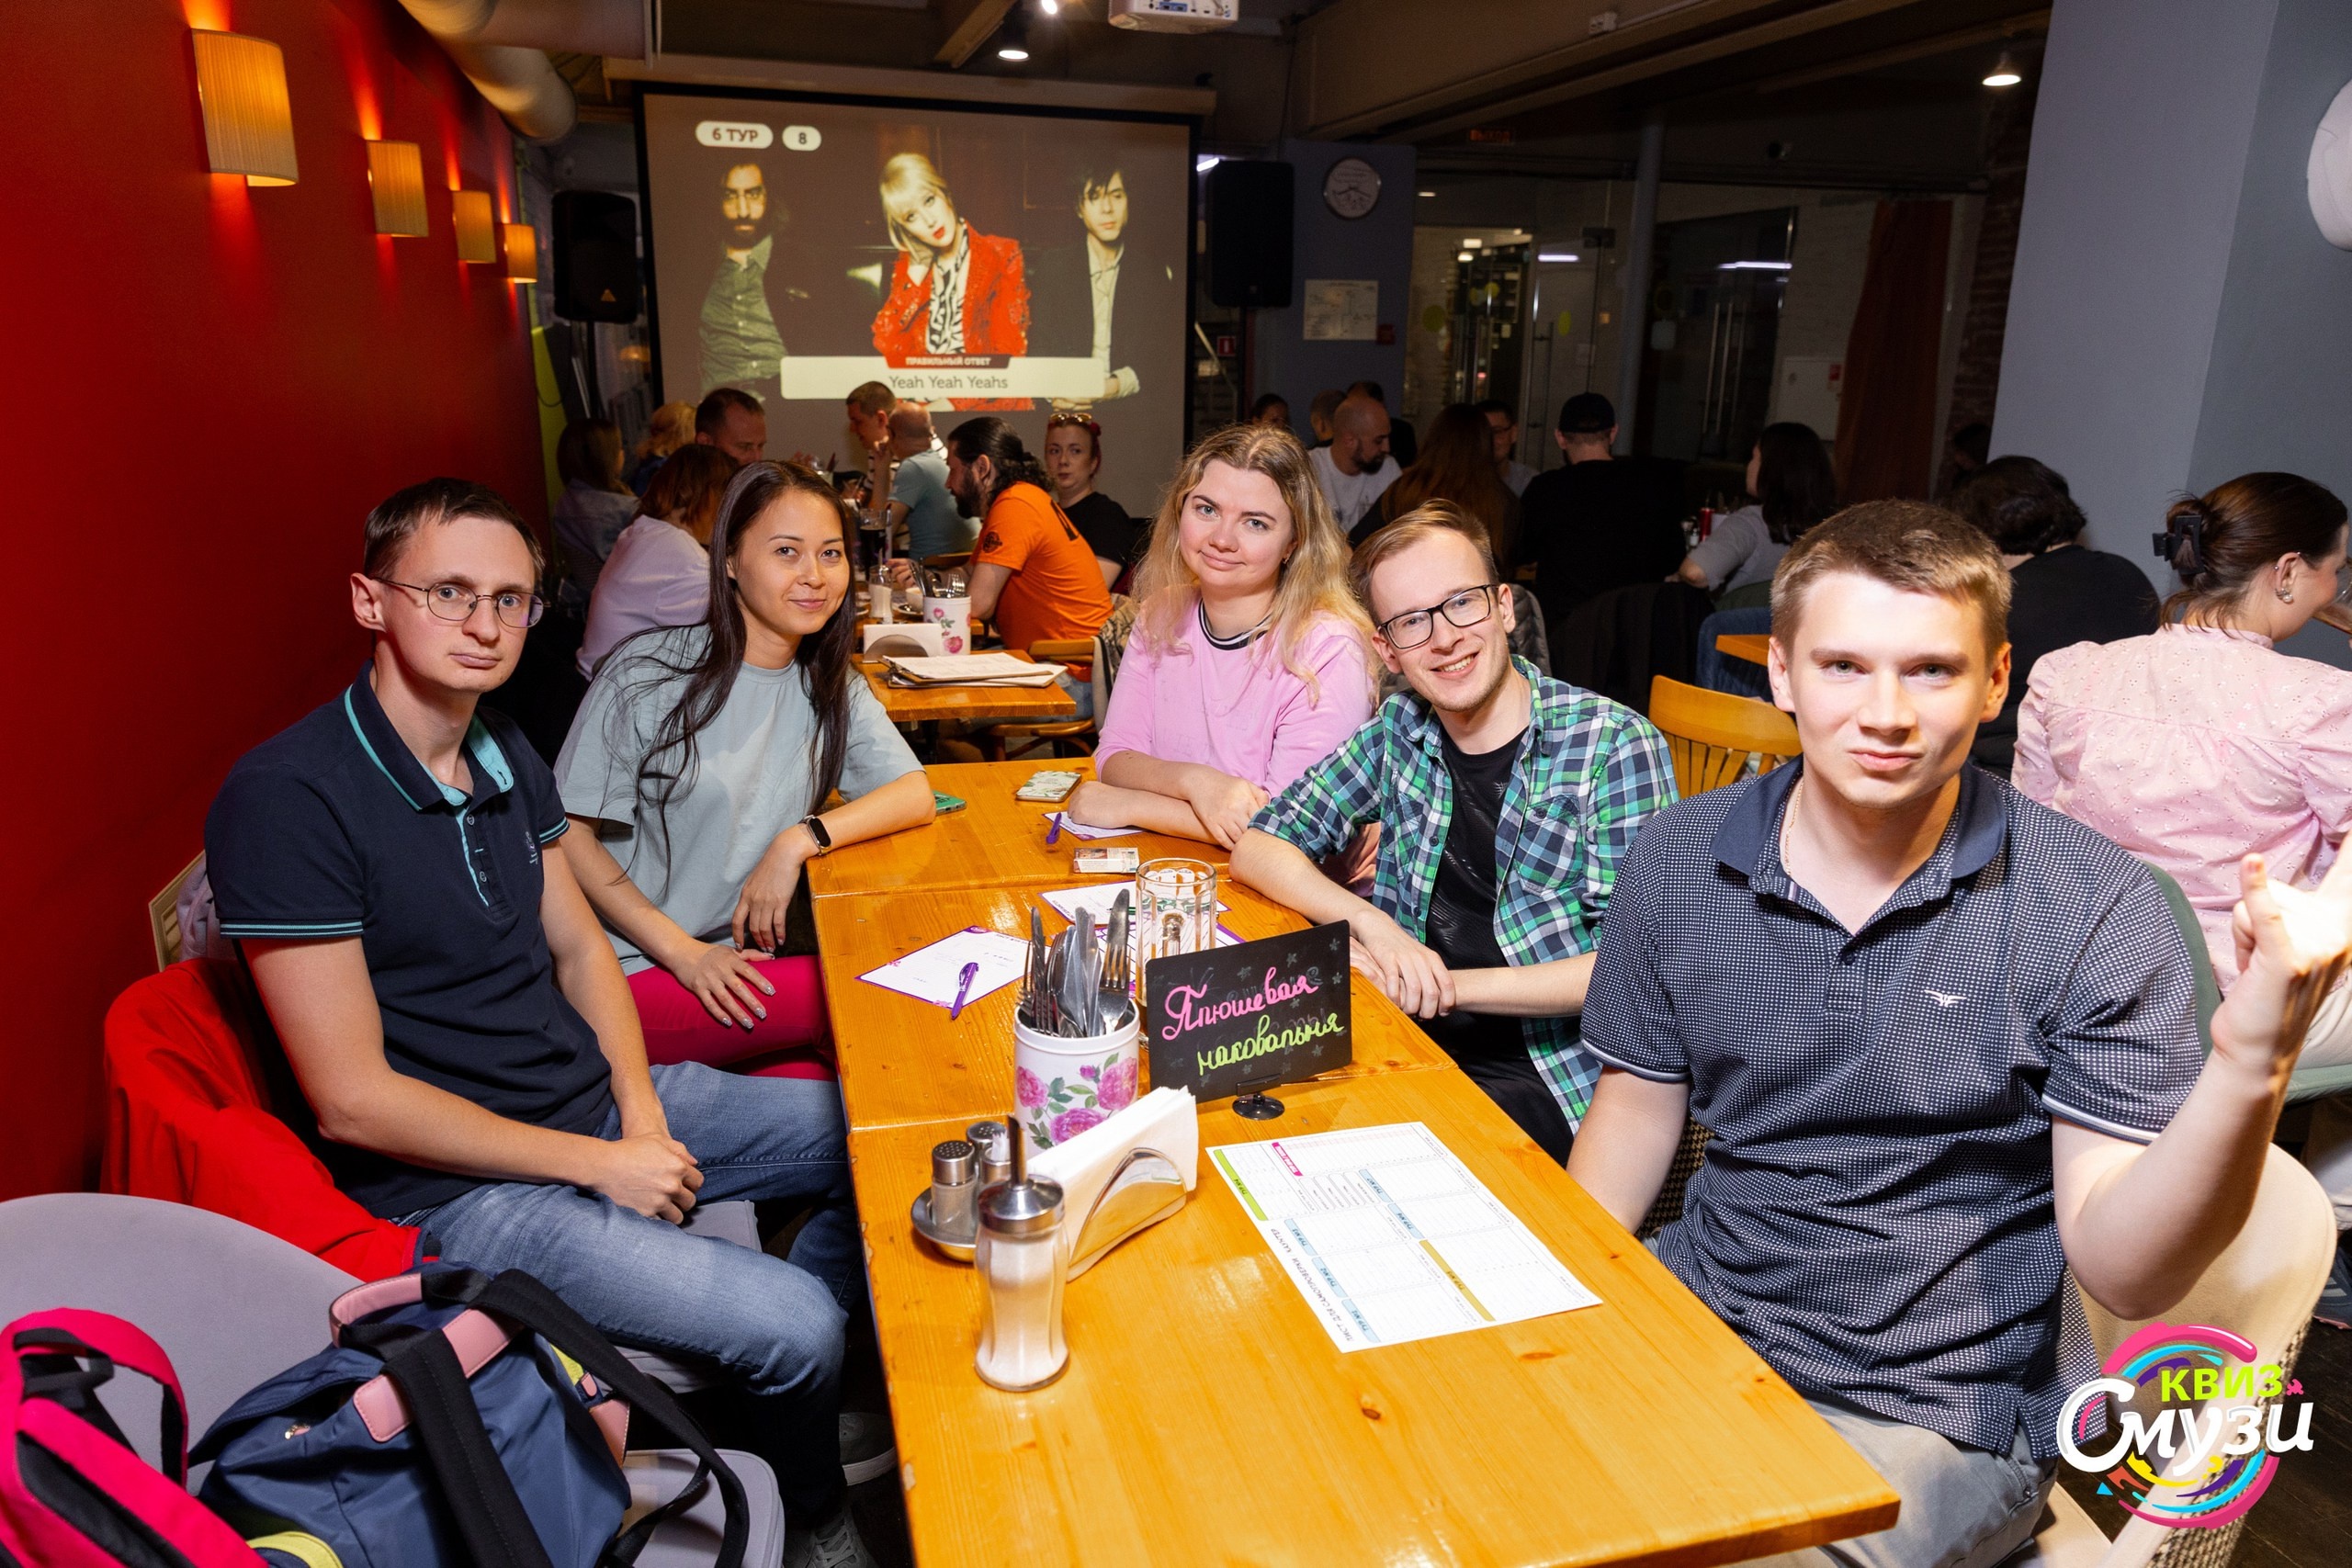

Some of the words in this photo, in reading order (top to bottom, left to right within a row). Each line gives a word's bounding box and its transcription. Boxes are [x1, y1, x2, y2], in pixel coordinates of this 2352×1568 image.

[711, 127, 722, 141] 6
[726, 128, 759, 143] ТУР
[797, 131, 808, 145] 8
[965, 356, 991, 367] ОТВЕТ
[889, 375, 924, 389] Yeah
[928, 375, 963, 389] Yeah
[967, 375, 1009, 389] Yeahs
[1161, 966, 1319, 1041] Плюшевая
